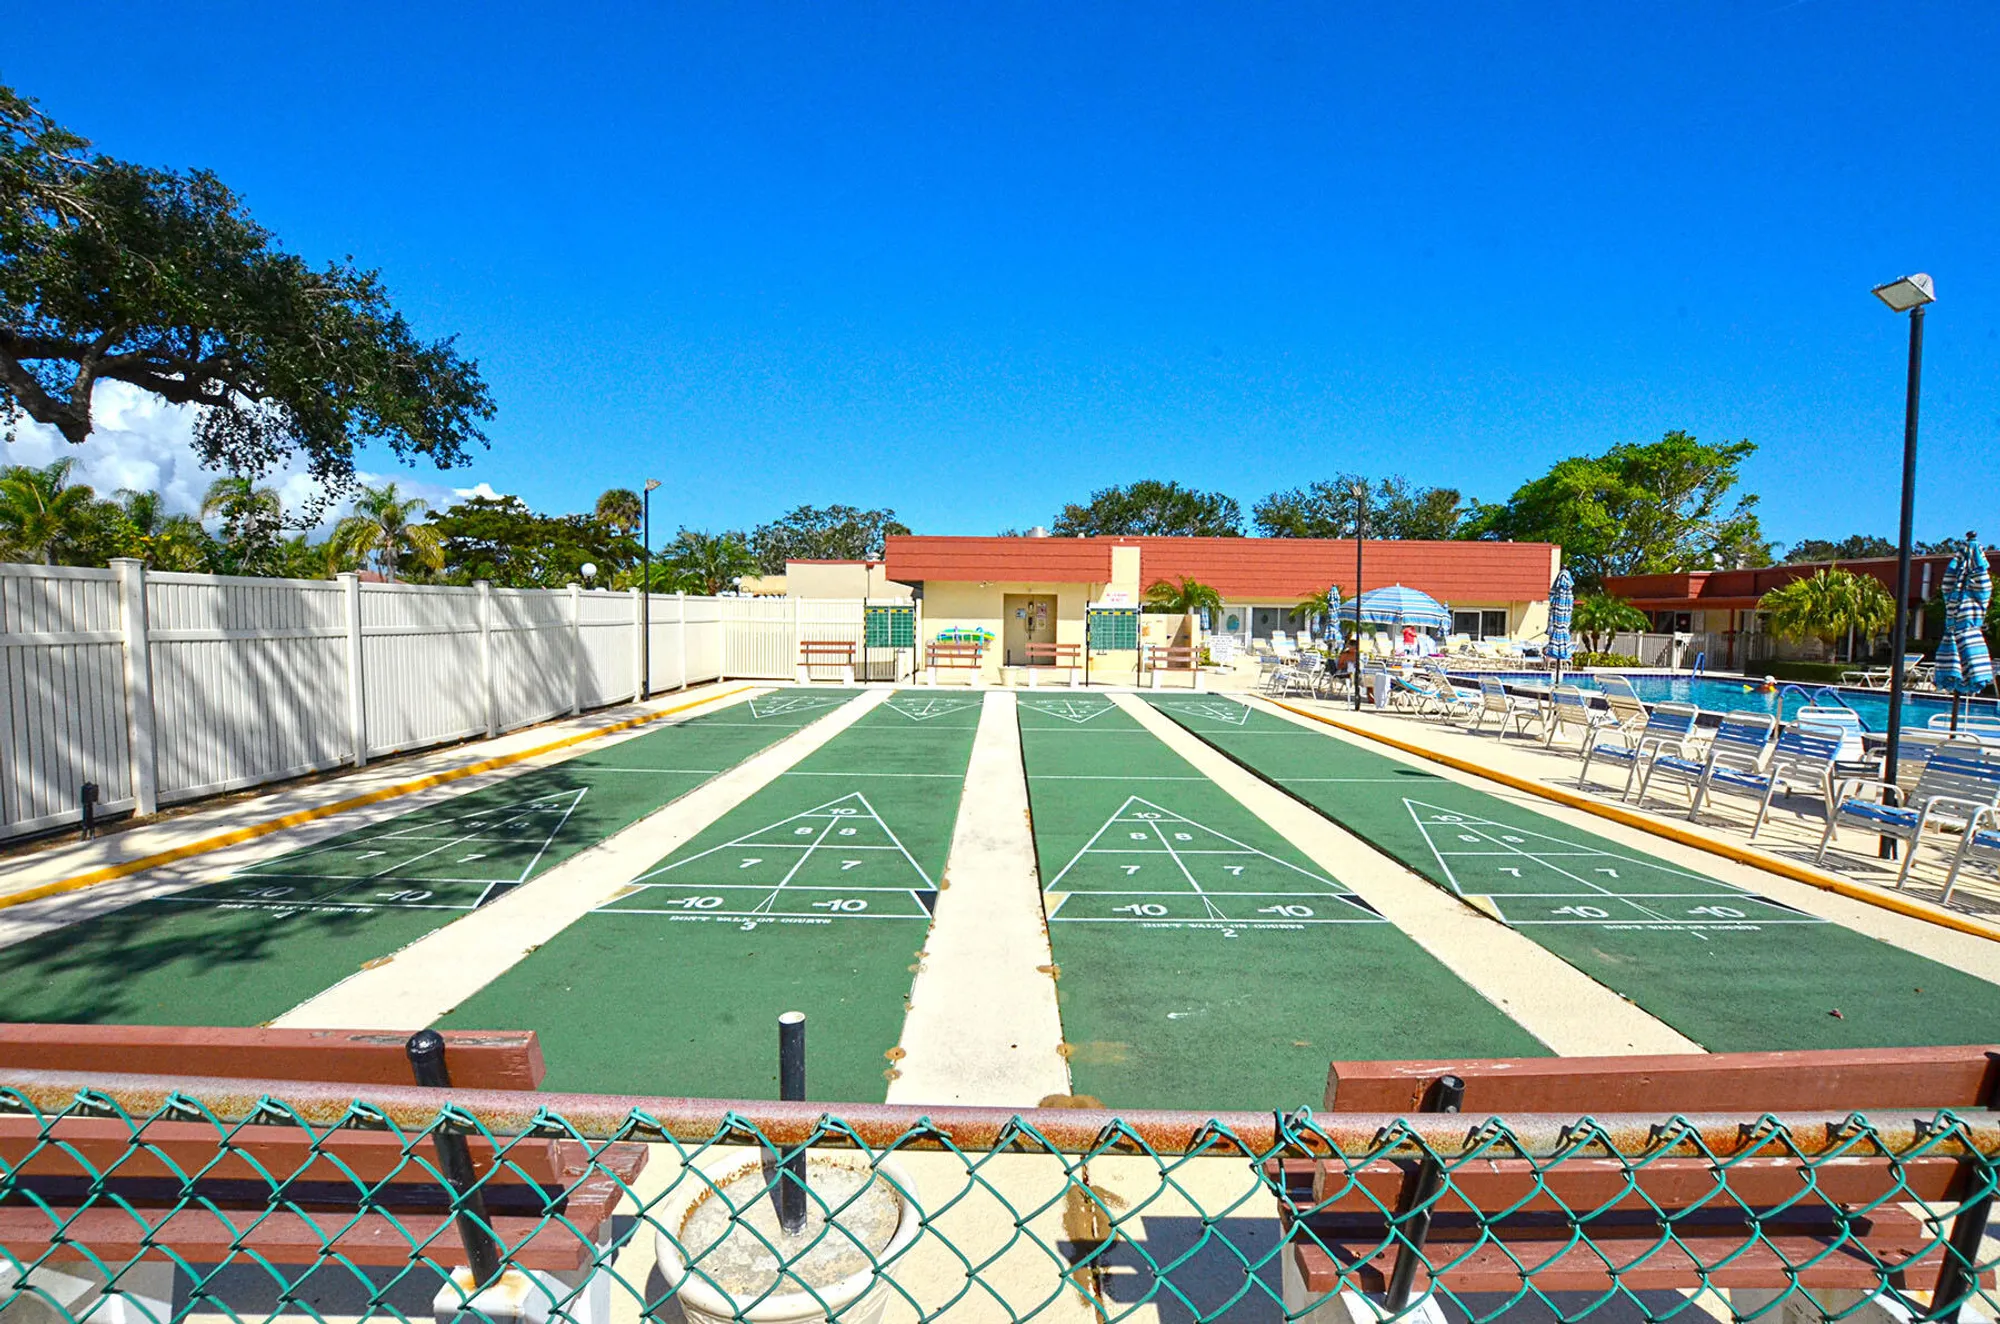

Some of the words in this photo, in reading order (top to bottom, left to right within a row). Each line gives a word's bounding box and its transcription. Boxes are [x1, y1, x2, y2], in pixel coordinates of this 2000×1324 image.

[1131, 811, 1162, 819] 10
[1430, 814, 1463, 822] 10
[794, 826, 814, 835] 8
[839, 827, 857, 836] 8
[1128, 832, 1148, 840] 8
[1174, 832, 1193, 841] 8
[1457, 834, 1481, 843] 8
[1501, 834, 1525, 844] 8
[355, 850, 387, 860] 7
[457, 853, 487, 864] 7
[739, 858, 763, 869] 7
[841, 860, 863, 870] 7
[1120, 865, 1141, 875] 7
[1223, 865, 1245, 876] 7
[1498, 867, 1523, 878] 7
[1594, 867, 1620, 879] 7
[376, 889, 433, 902] -10
[666, 895, 724, 909] -10
[812, 898, 869, 912] -10
[1112, 903, 1169, 916] -10
[1257, 904, 1315, 917] -10
[1551, 905, 1610, 918] -10
[1687, 905, 1746, 918] -10
[739, 921, 758, 931] 3
[1220, 927, 1239, 938] 2
